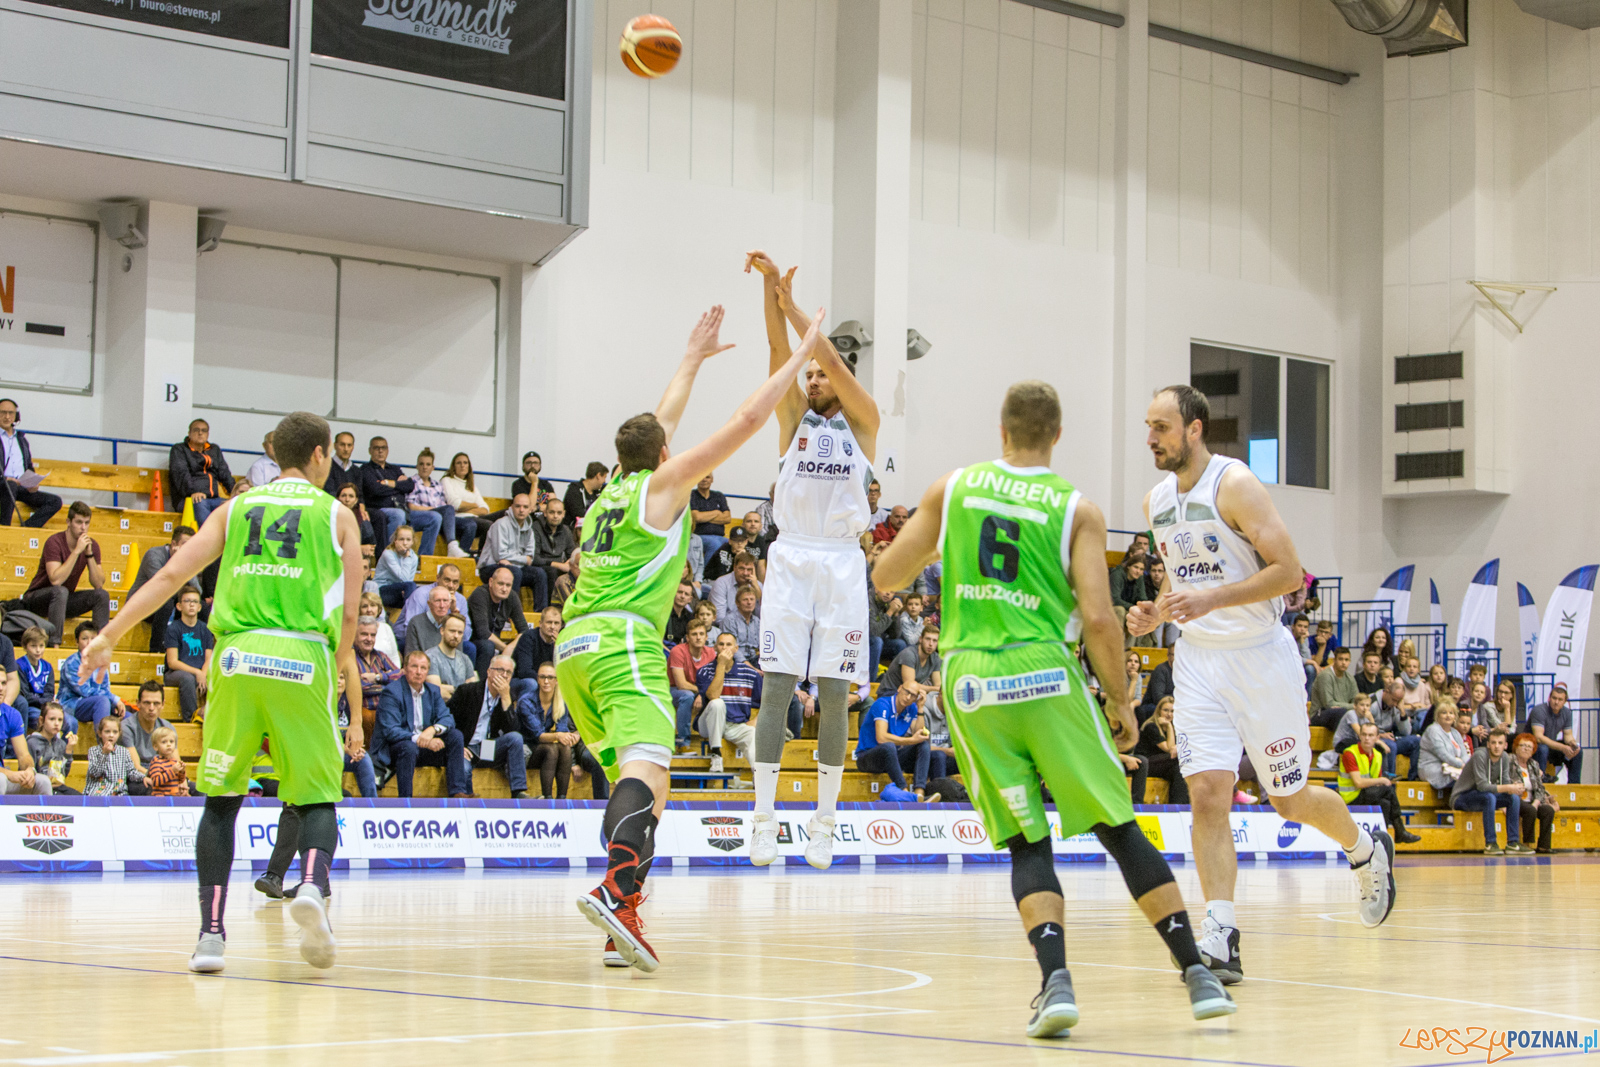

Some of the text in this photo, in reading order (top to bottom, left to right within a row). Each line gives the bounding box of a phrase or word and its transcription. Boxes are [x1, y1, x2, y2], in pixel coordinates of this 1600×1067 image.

[413, 25, 505, 50] BIKE & SERVICE
[165, 383, 179, 402] B
[817, 434, 834, 458] 9
[885, 457, 895, 473] A
[247, 482, 324, 498] UNIBEN
[965, 470, 1062, 509] UNIBEN
[121, 520, 129, 528] 14
[243, 505, 302, 559] 14
[978, 514, 1020, 584] 6
[1173, 531, 1200, 560] 12
[16, 567, 25, 575] 16
[233, 563, 304, 579] PRUSZKÓW
[109, 601, 118, 609] 15
[954, 584, 1042, 611] PRUSZKÓW
[762, 630, 776, 654] 9
[1556, 609, 1577, 667] DELIK
[242, 653, 313, 674] ELEKTROBUD
[248, 665, 304, 681] INVESTMENT
[986, 670, 1066, 692] ELEKTROBUD
[997, 684, 1061, 701] INVESTMENT
[1270, 740, 1292, 755] KIA
[1269, 755, 1298, 773] DELIK
[1281, 768, 1302, 788] PBG
[26, 825, 69, 838] JOKER
[362, 819, 460, 840] BIOFARM
[474, 819, 568, 840] BIOFARM
[708, 827, 740, 838] JOKER
[797, 824, 861, 842] NKEL
[872, 825, 900, 840] KIA
[911, 825, 947, 839] DELIK
[959, 825, 983, 840] KIA
[1278, 826, 1300, 838] atrem
[434, 841, 454, 849] LEKÓW
[544, 841, 562, 849] LEKÓW
